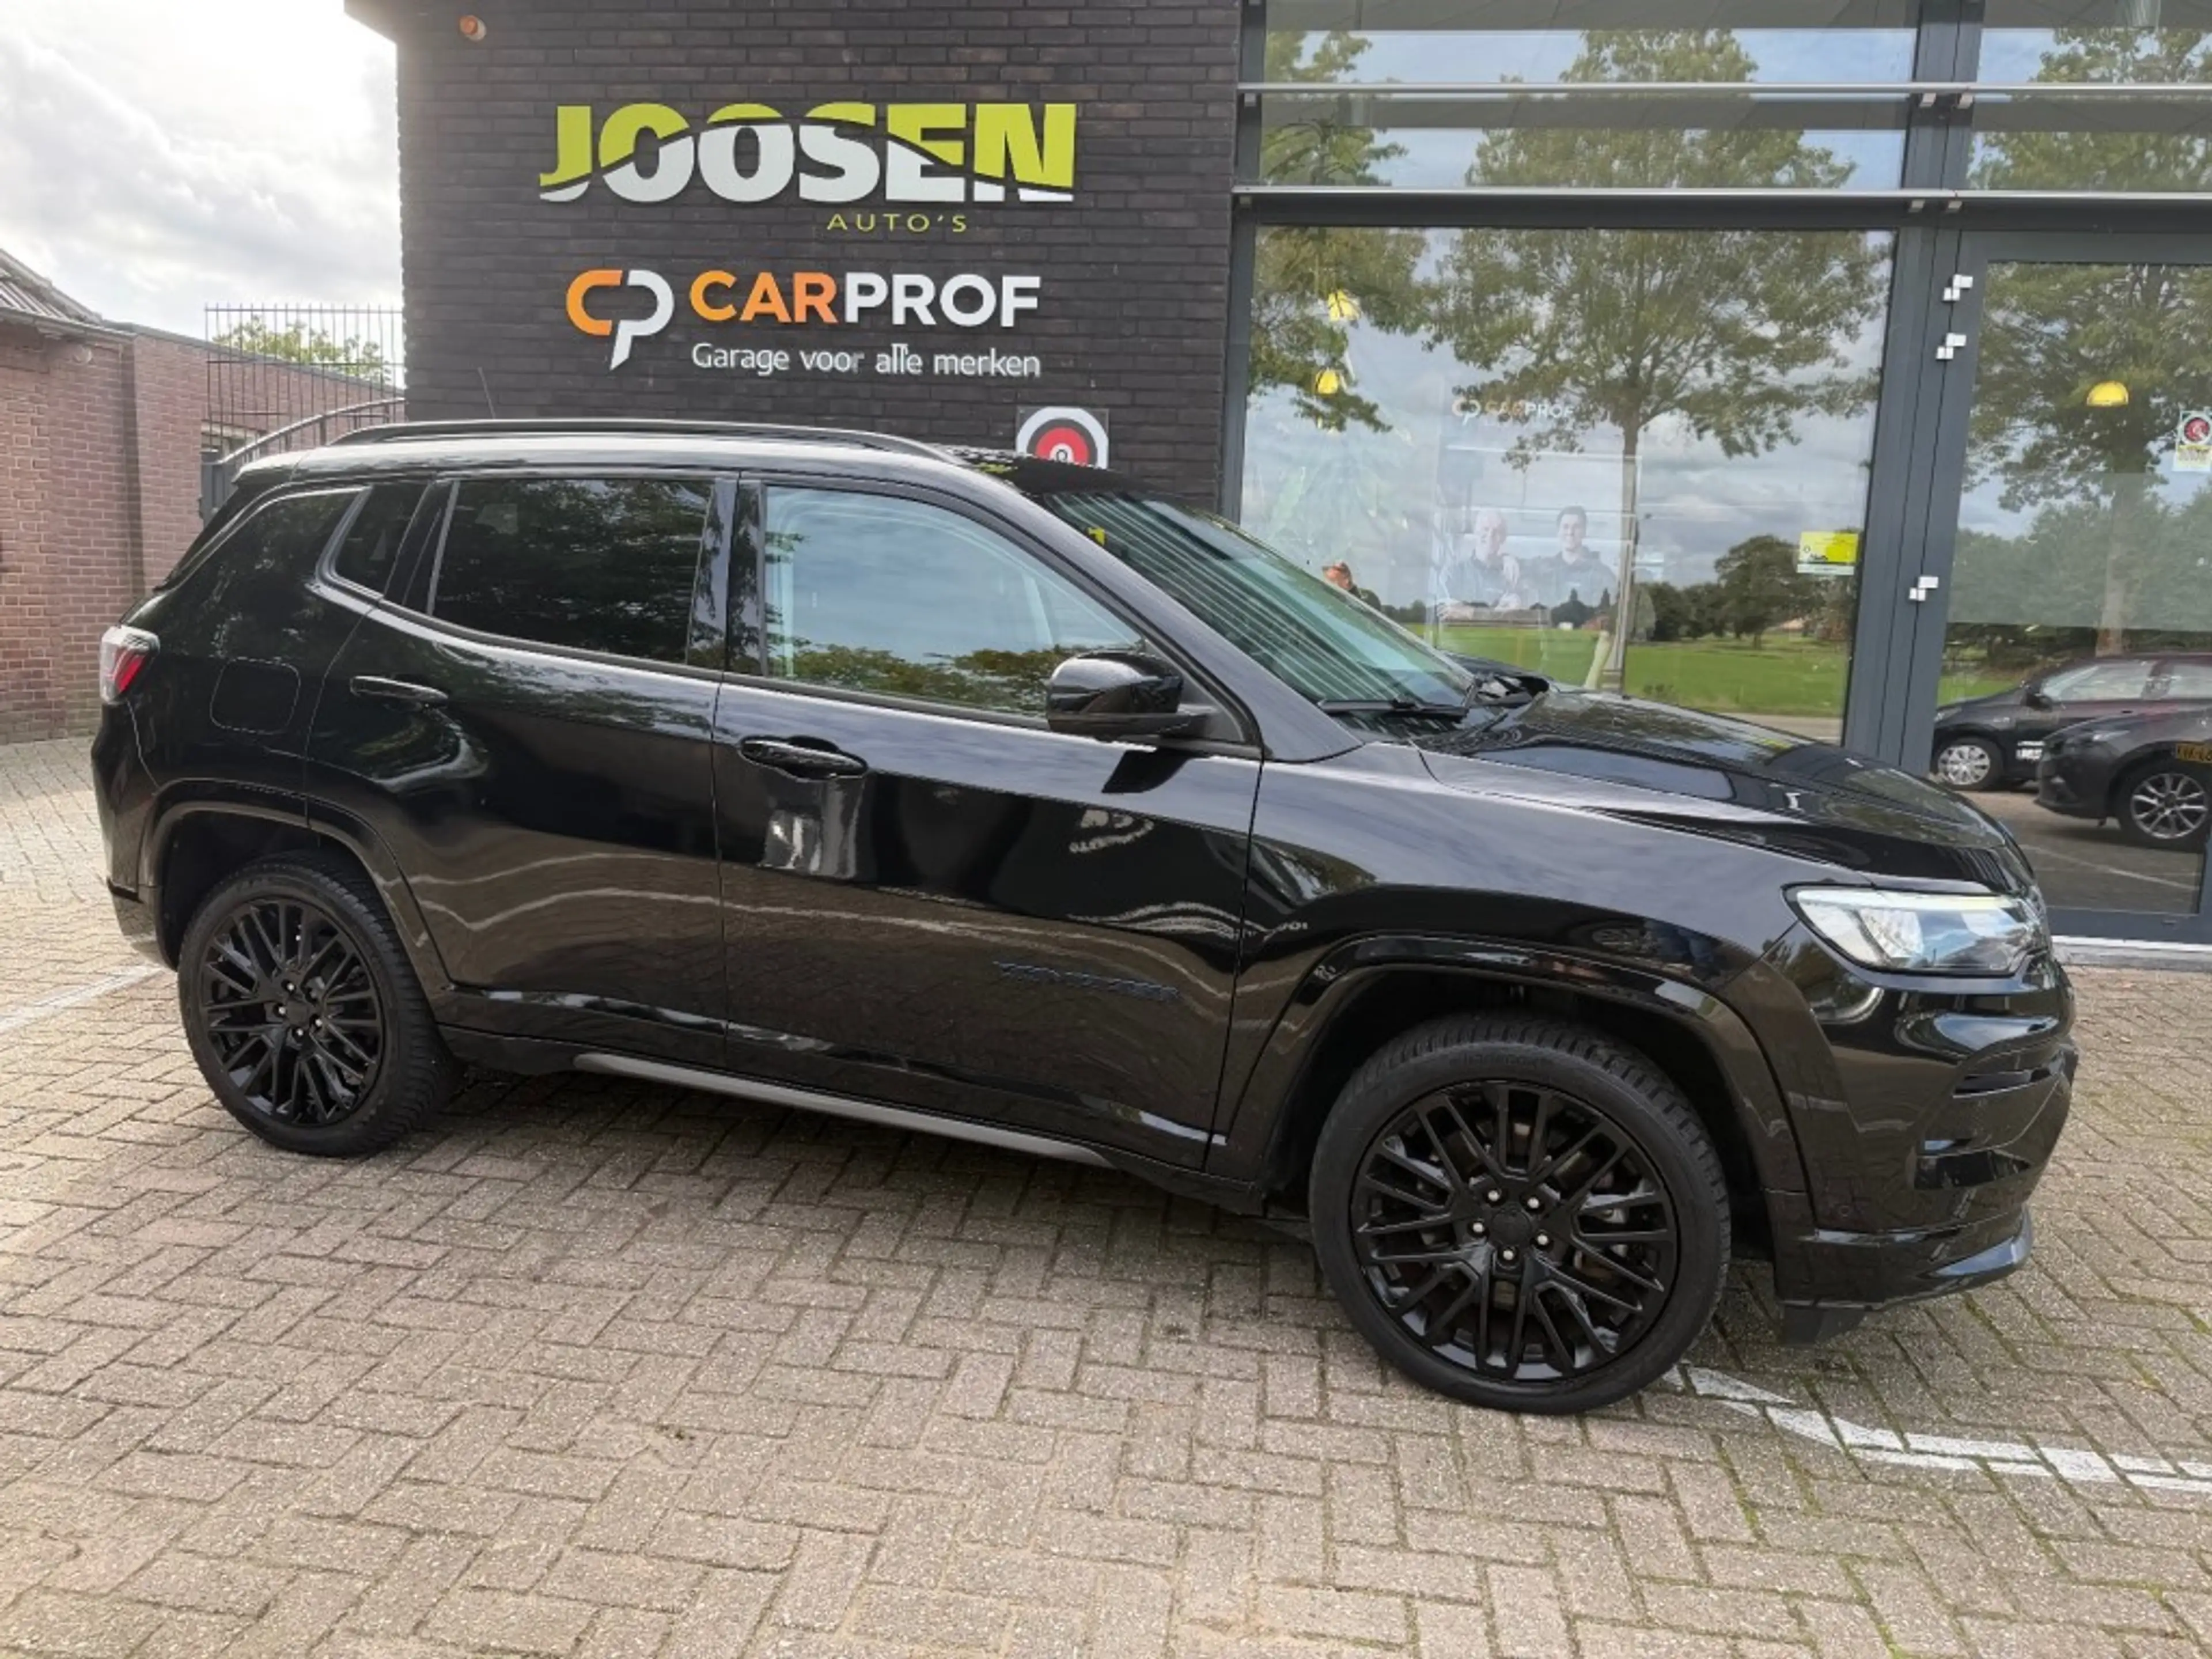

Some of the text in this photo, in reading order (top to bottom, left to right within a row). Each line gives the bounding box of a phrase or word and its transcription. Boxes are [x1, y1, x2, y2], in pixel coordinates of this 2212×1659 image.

[539, 102, 1077, 202] JOOSEN
[827, 213, 967, 232] AUTO'S
[689, 270, 1041, 327] CARPROF
[692, 342, 1041, 377] Garage voor alle merken
